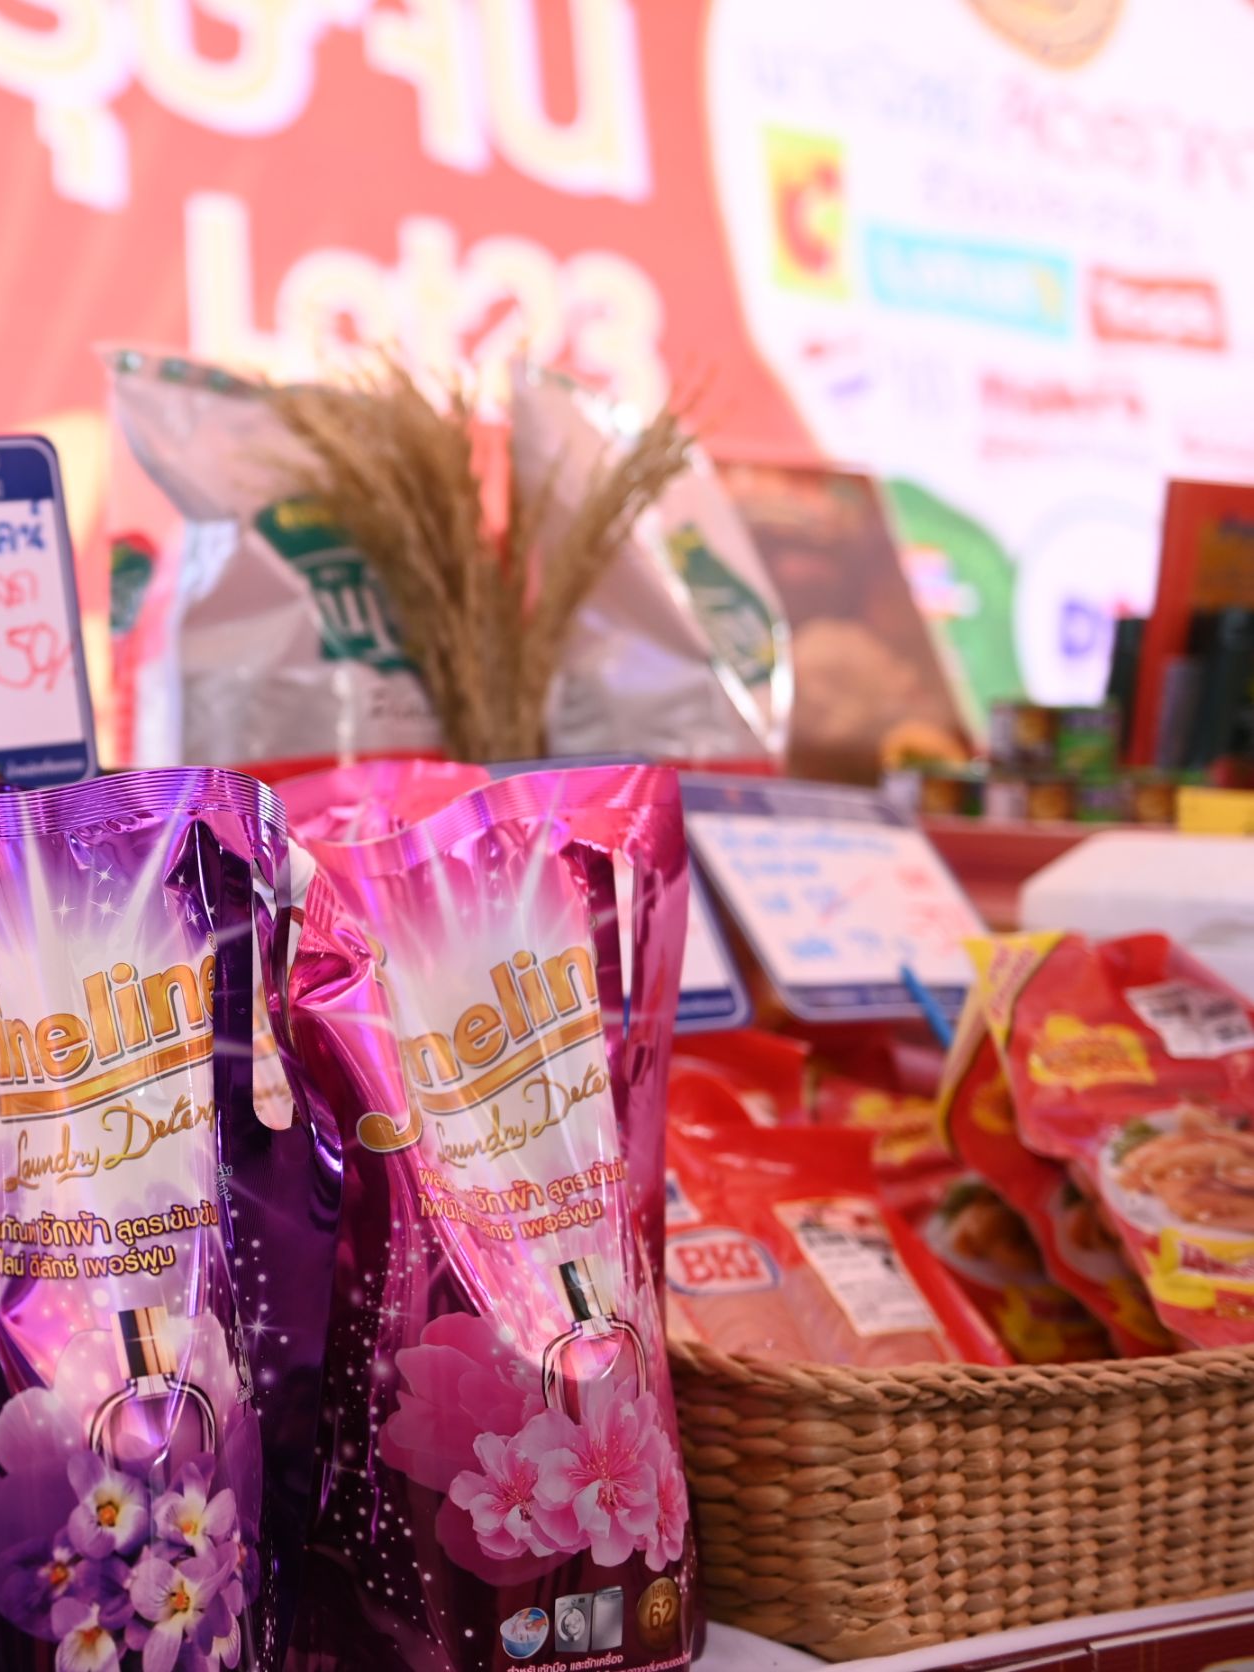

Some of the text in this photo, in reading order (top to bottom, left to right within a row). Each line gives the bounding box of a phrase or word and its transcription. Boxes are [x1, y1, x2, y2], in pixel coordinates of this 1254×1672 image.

[4, 1123, 100, 1193] Laundry
[83, 1245, 177, 1279] เพอร์ฟูม
[648, 1597, 674, 1630] 62
